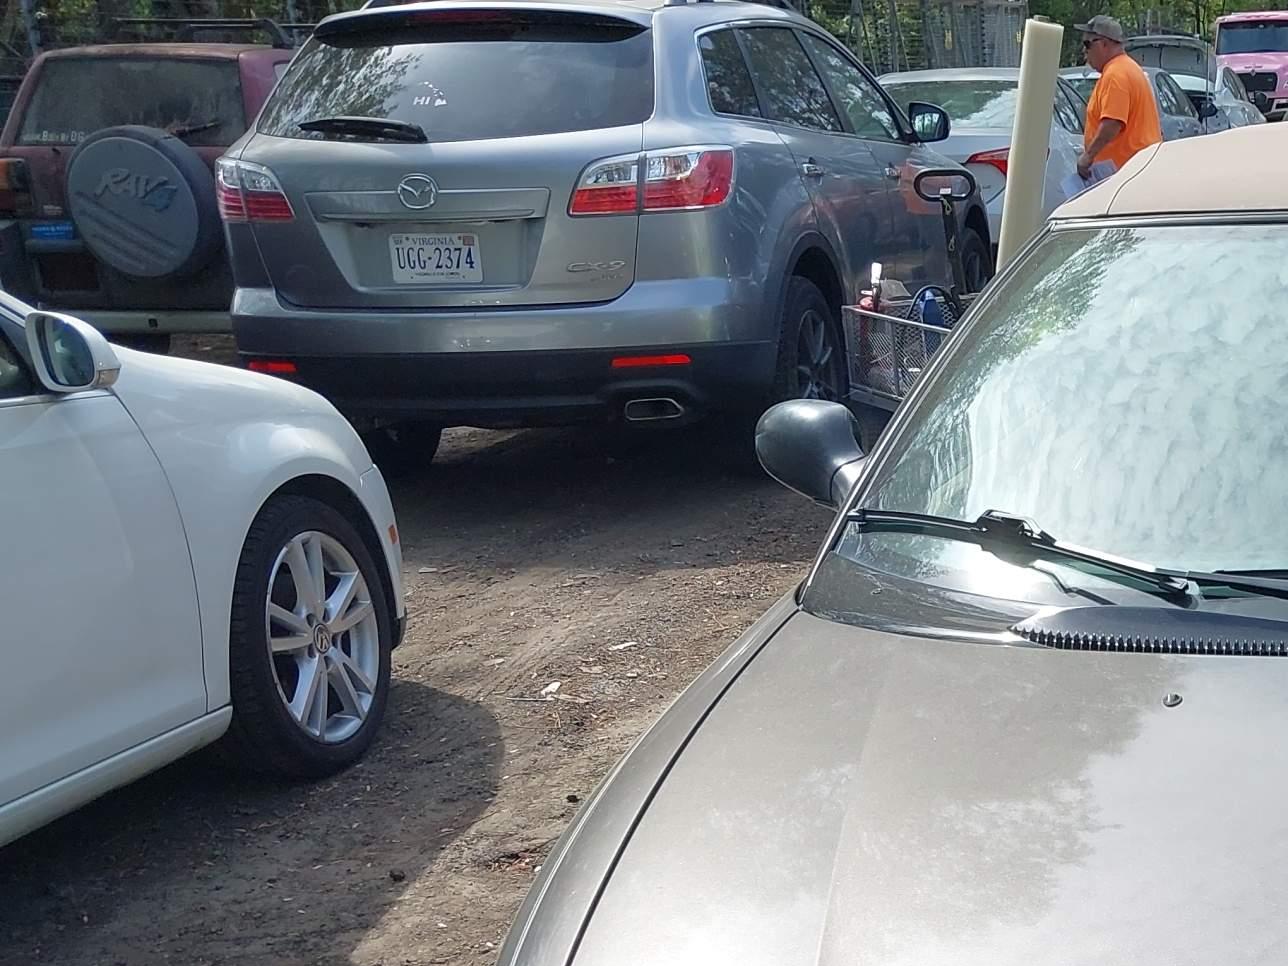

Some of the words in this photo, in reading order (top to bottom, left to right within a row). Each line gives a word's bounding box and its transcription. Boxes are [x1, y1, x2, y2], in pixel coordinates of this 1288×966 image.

[413, 96, 431, 105] HI
[412, 235, 456, 246] VIRGINIA
[395, 246, 475, 270] UGG-2374
[567, 260, 626, 273] CX-9
